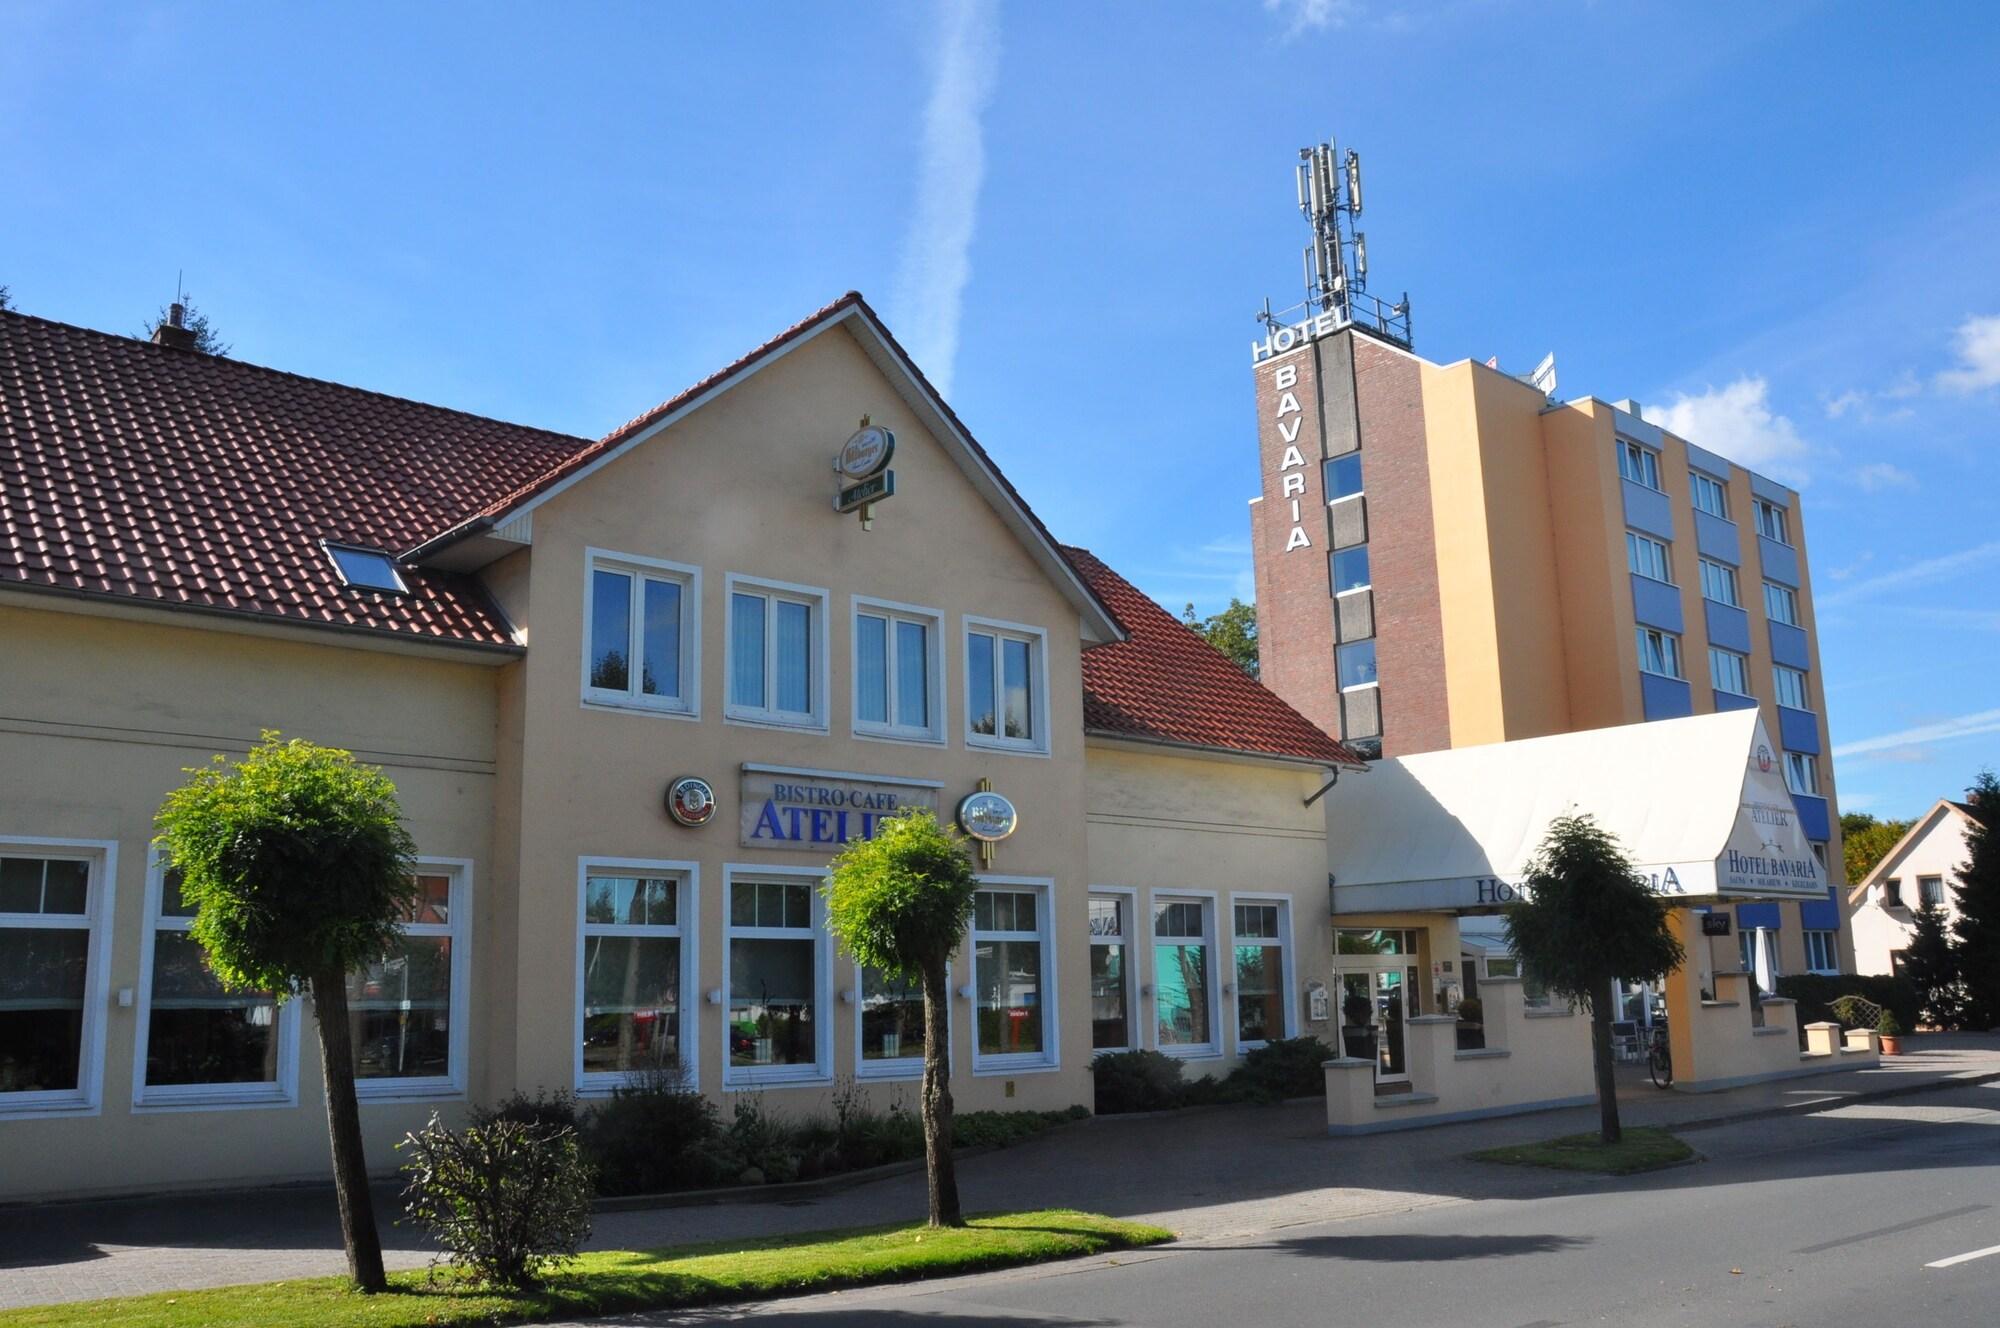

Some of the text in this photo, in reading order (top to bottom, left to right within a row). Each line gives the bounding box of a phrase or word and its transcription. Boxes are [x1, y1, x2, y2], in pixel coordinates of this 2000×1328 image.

[1251, 306, 1352, 362] HOTEL
[1275, 364, 1312, 552] BAVARIA
[751, 798, 897, 844] ATELI
[1752, 807, 1788, 827] ATELIER
[1728, 849, 1816, 879] HOTEL BAVARIA
[1706, 917, 1727, 931] sky
